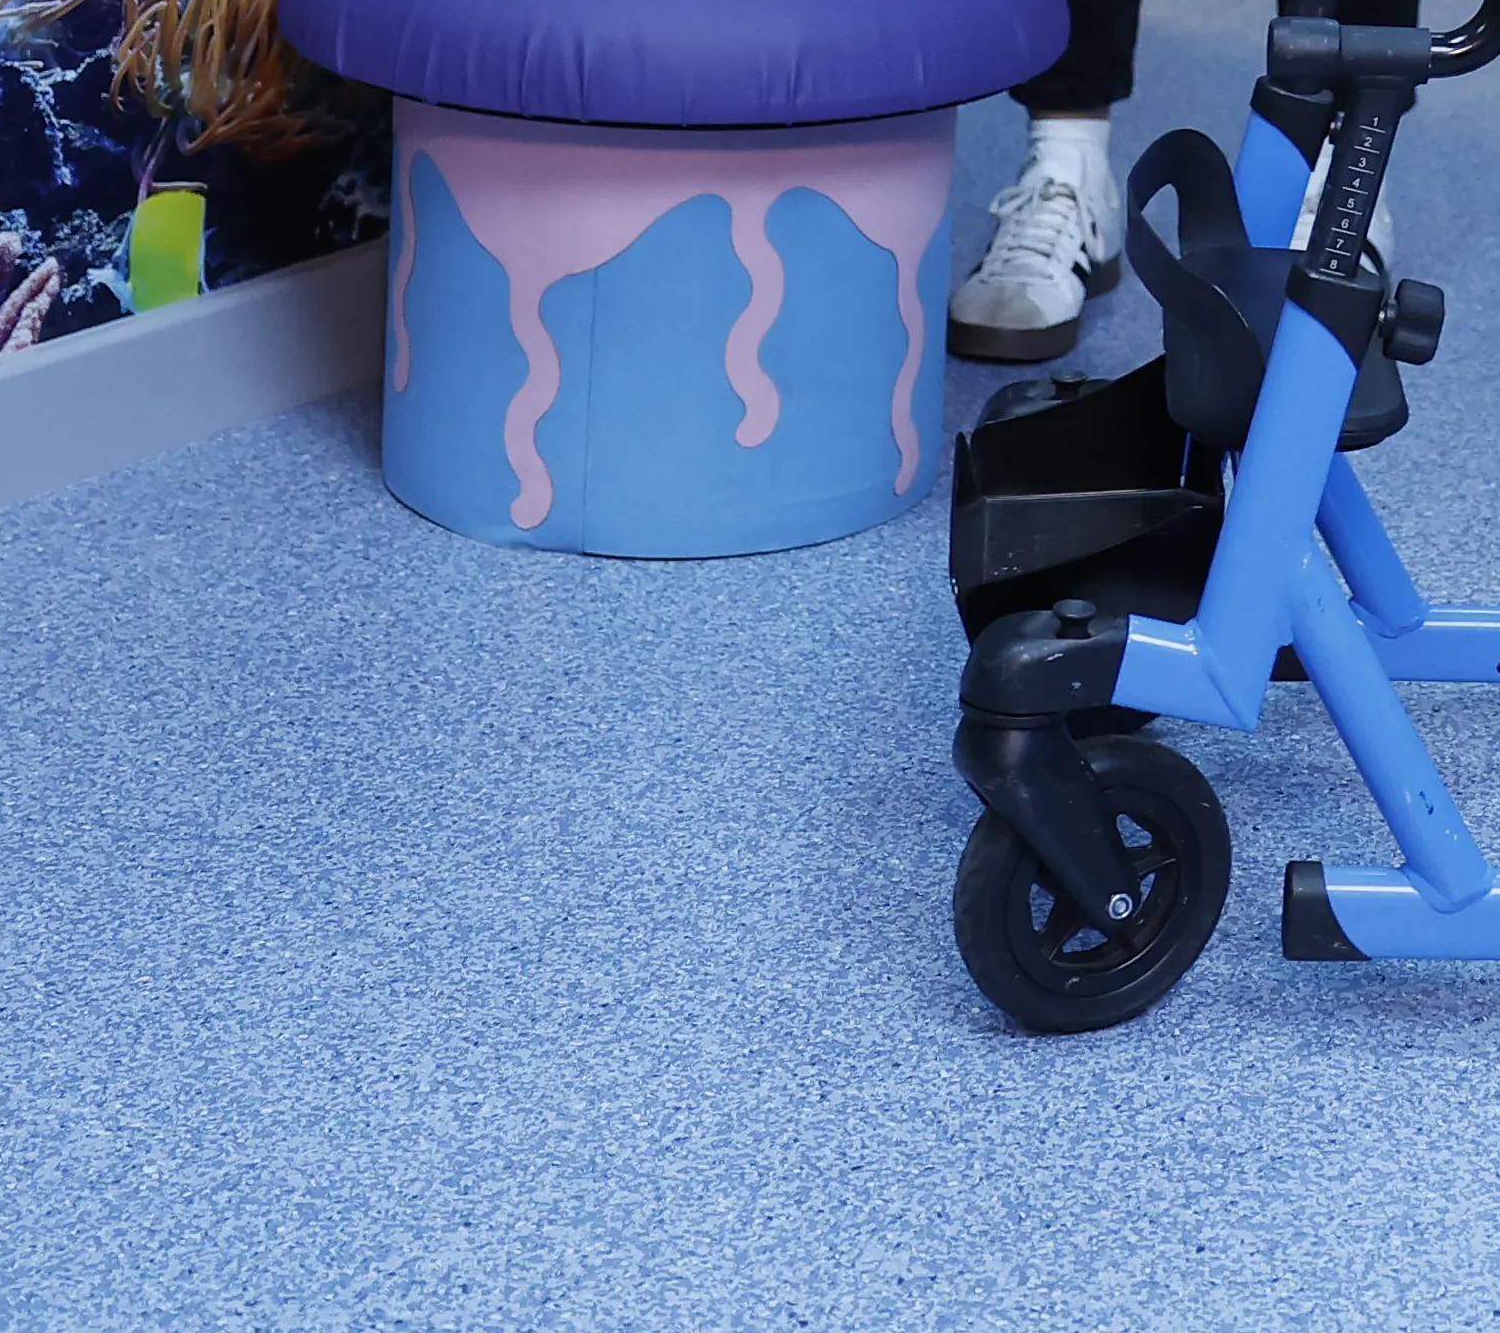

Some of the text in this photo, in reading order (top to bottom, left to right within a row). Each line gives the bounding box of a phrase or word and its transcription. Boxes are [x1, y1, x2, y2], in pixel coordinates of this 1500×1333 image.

[1372, 117, 1379, 127] 1
[1363, 137, 1373, 147] 2
[1358, 157, 1367, 168] 3
[1352, 177, 1361, 188] 4
[1346, 198, 1355, 208] 5
[1341, 218, 1349, 229] 6
[1336, 239, 1344, 249] 7
[1329, 259, 1338, 270] 8
